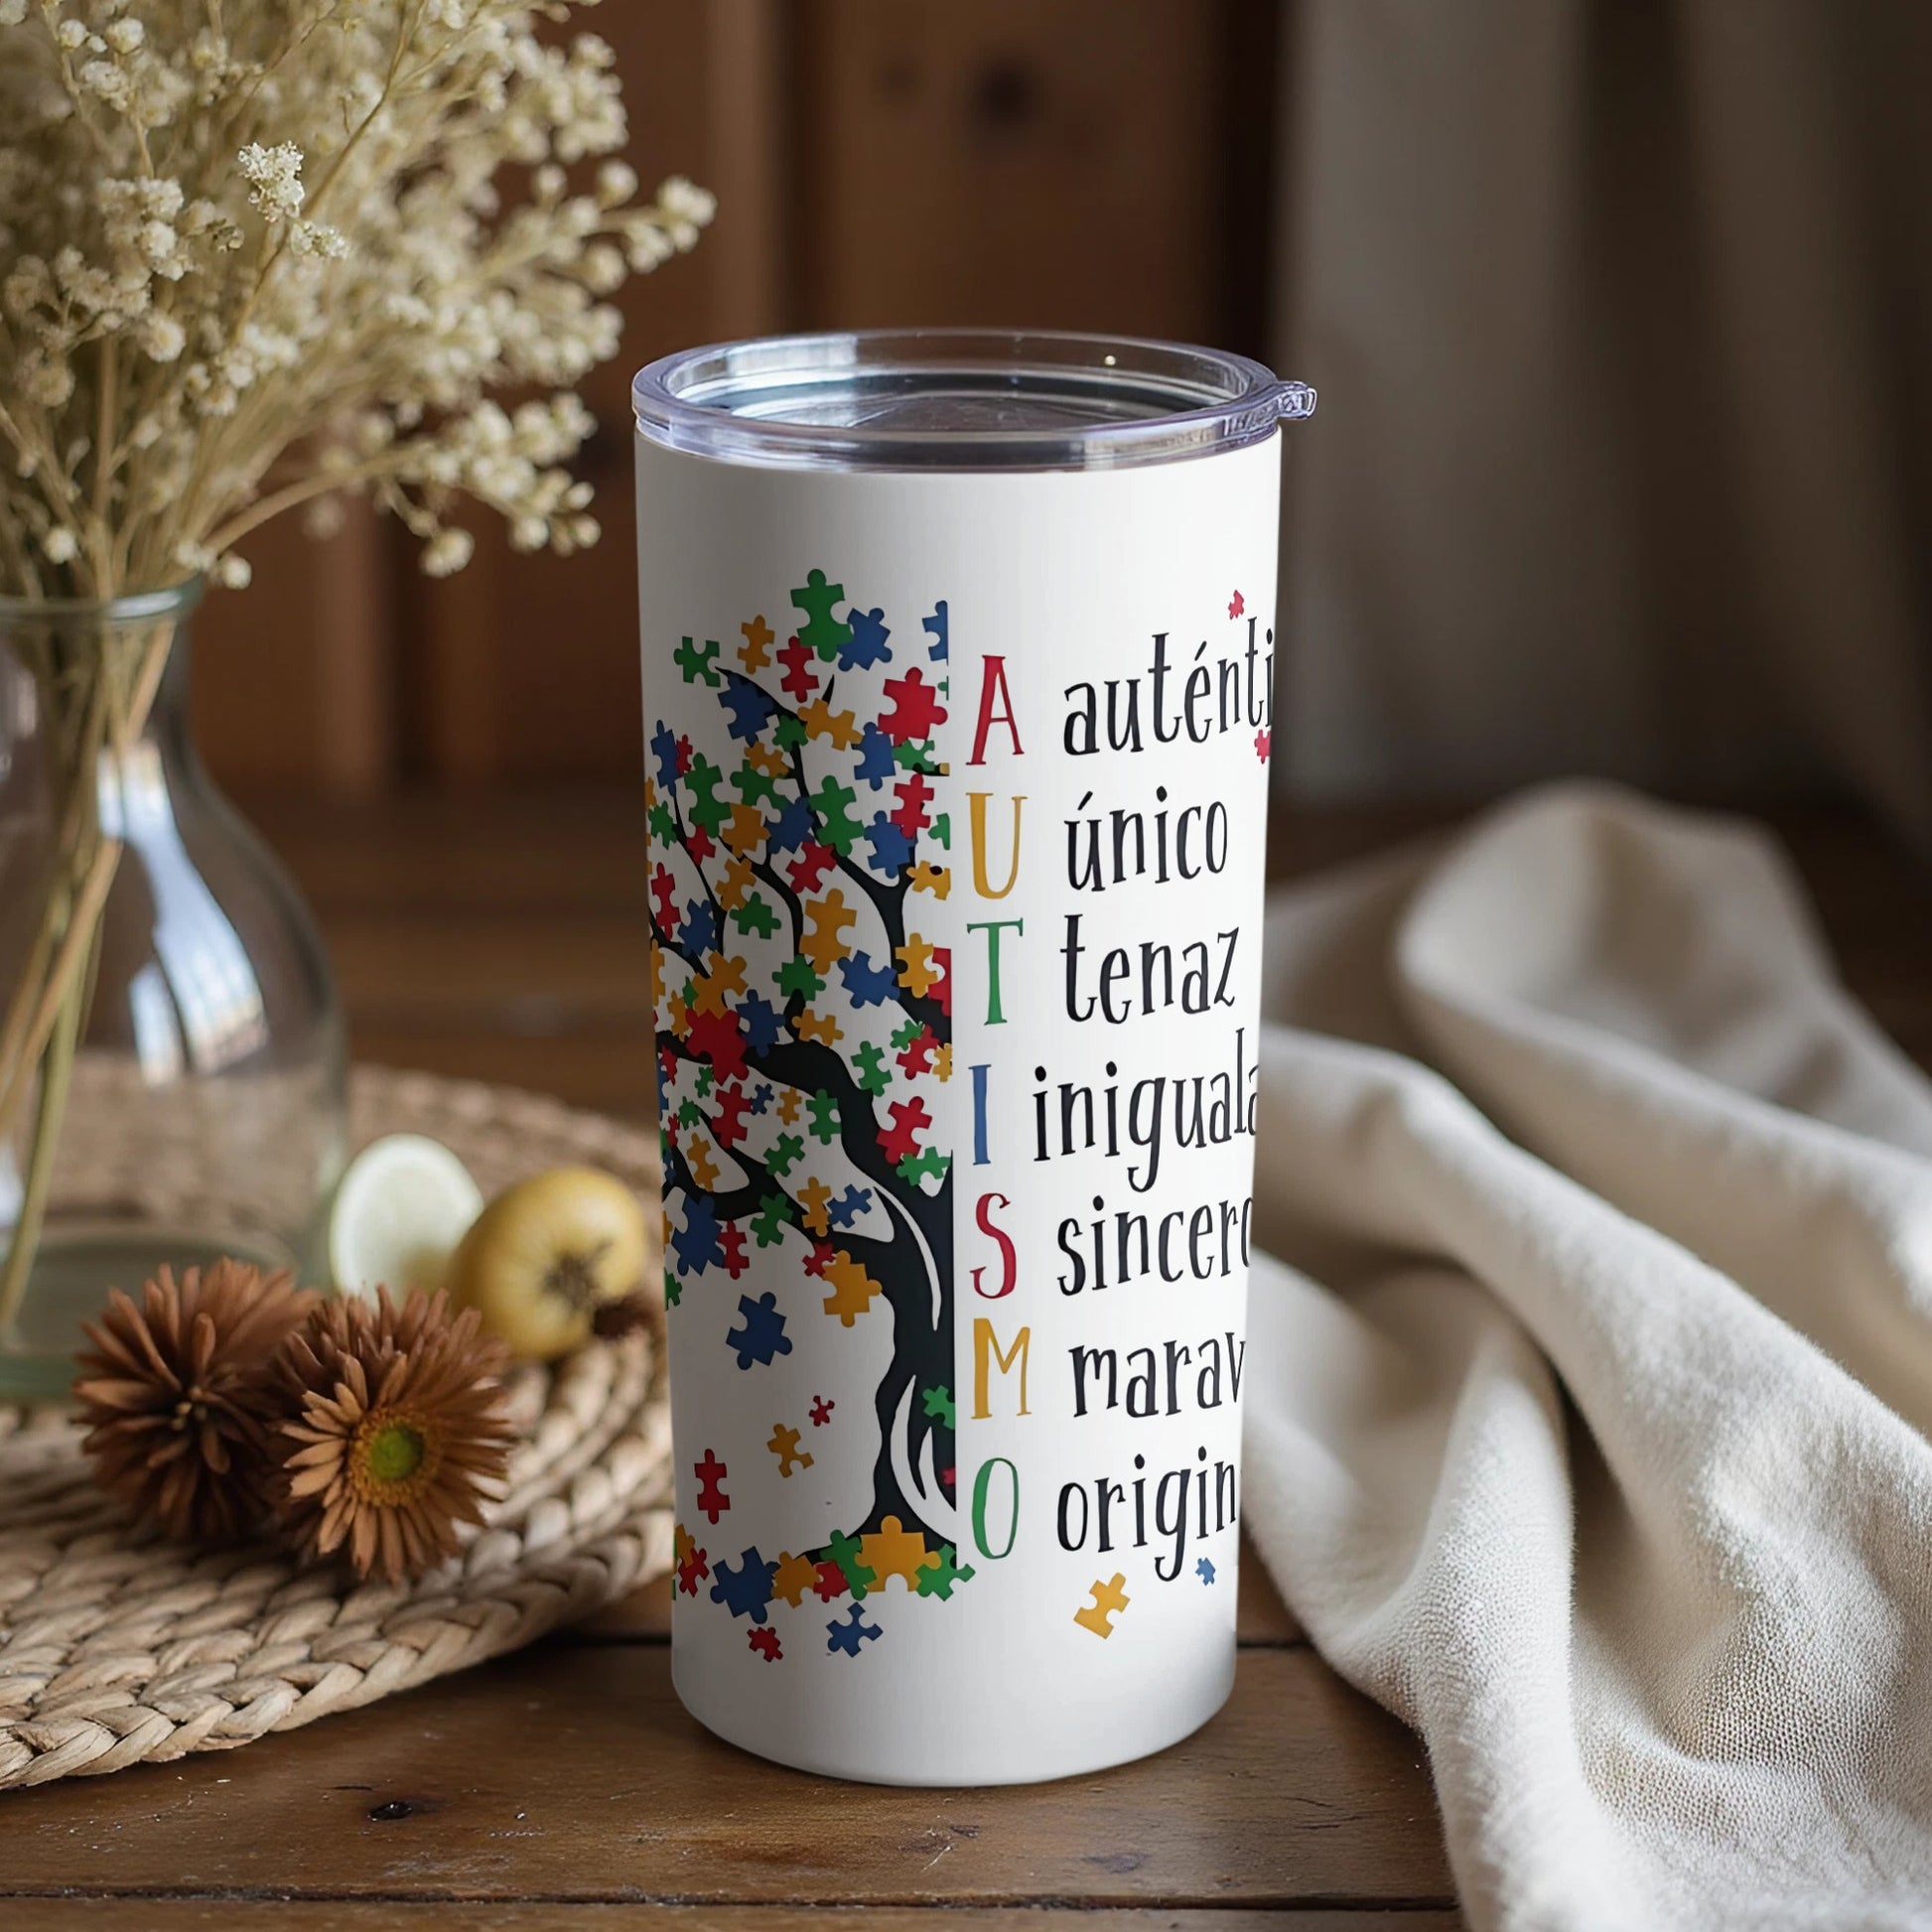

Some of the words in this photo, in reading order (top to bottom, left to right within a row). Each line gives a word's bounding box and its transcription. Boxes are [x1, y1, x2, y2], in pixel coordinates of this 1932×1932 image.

[966, 655, 1025, 765] A
[966, 792, 1028, 899] U
[1064, 785, 1228, 893] único
[966, 917, 1024, 1026] T
[1059, 913, 1239, 1025] tenaz
[968, 1064, 992, 1166] I
[969, 1192, 1017, 1299] S
[970, 1317, 1033, 1420] M
[971, 1456, 1020, 1560] O
[1056, 1446, 1236, 1583] origin
